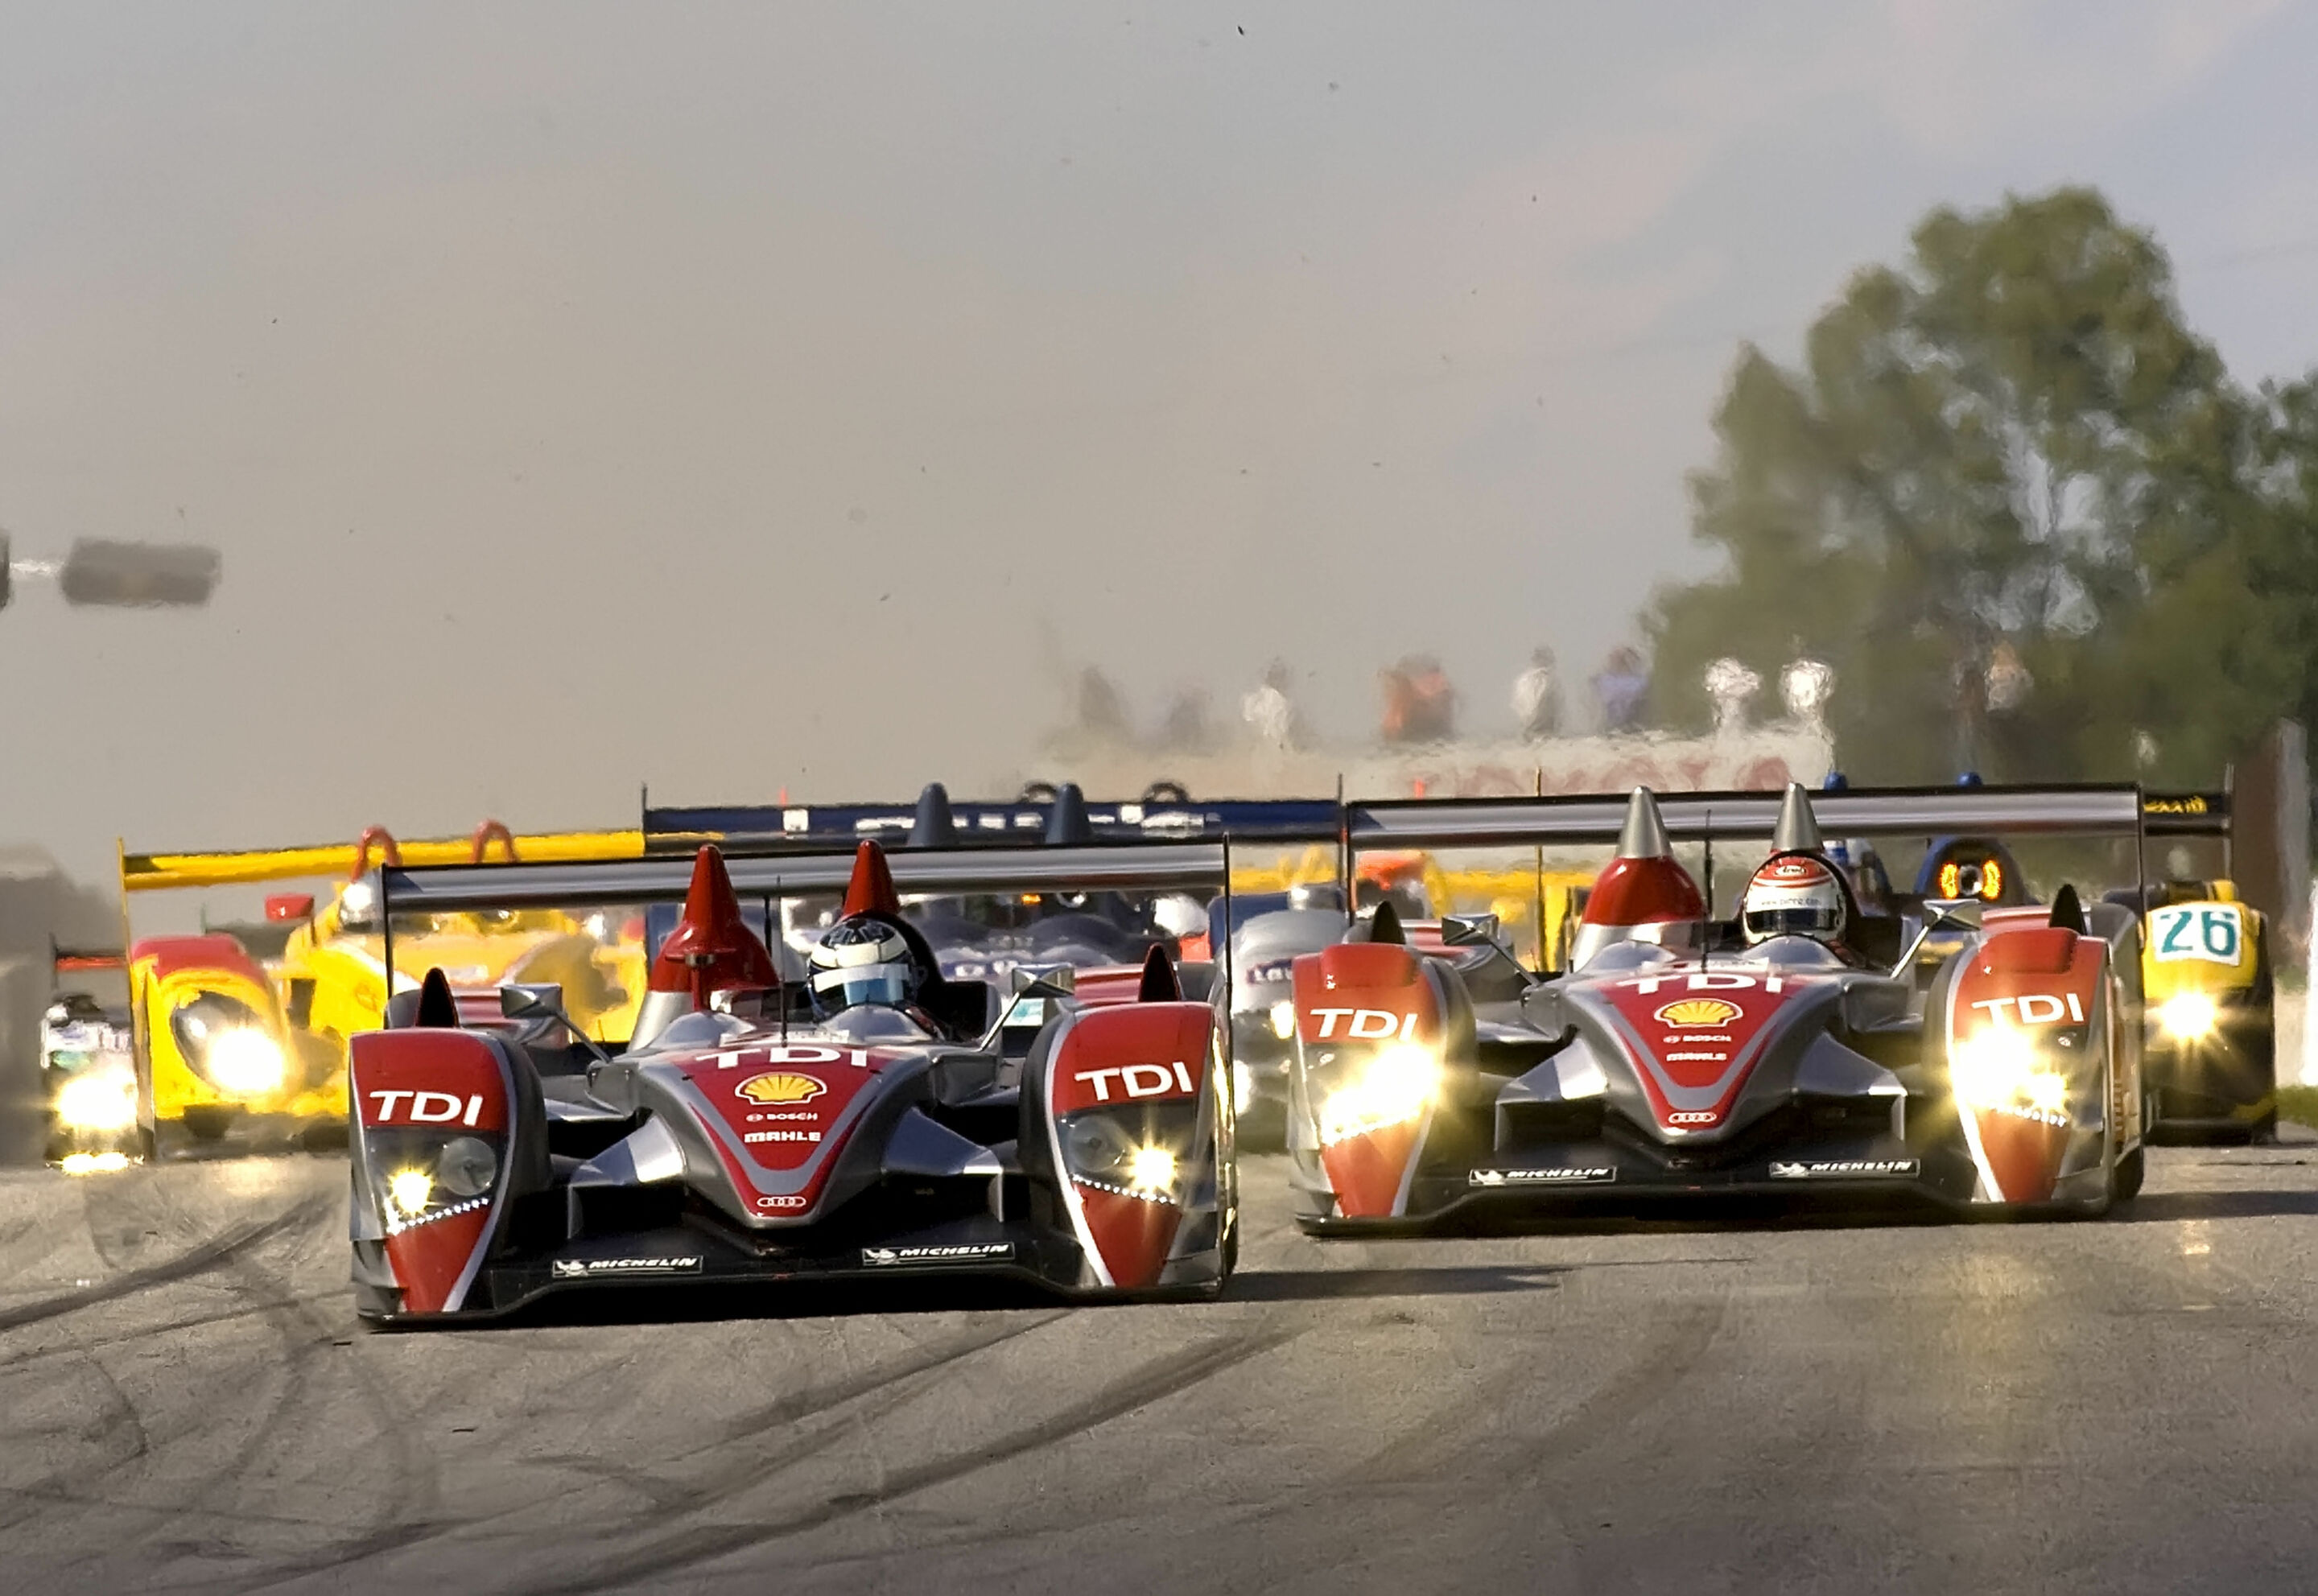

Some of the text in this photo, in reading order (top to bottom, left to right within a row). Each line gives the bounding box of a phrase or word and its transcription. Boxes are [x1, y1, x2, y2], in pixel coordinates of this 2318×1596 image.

[2160, 911, 2235, 956] 26
[1616, 973, 1782, 995] TDI
[1971, 992, 2084, 1027] TDI
[1310, 1008, 1418, 1041] TDI
[1683, 1034, 1731, 1042] BOSCH
[696, 1046, 868, 1070] TDI
[1074, 1062, 1194, 1101] TDI
[369, 1091, 483, 1126] TDI
[767, 1112, 819, 1120] BOSCH
[744, 1131, 821, 1143] MAHLE
[1508, 1168, 1609, 1178] MICHELIN
[1811, 1161, 1912, 1172] MICHELIN
[899, 1243, 1009, 1257] MICHELIN
[589, 1257, 698, 1269] MICHELIN
